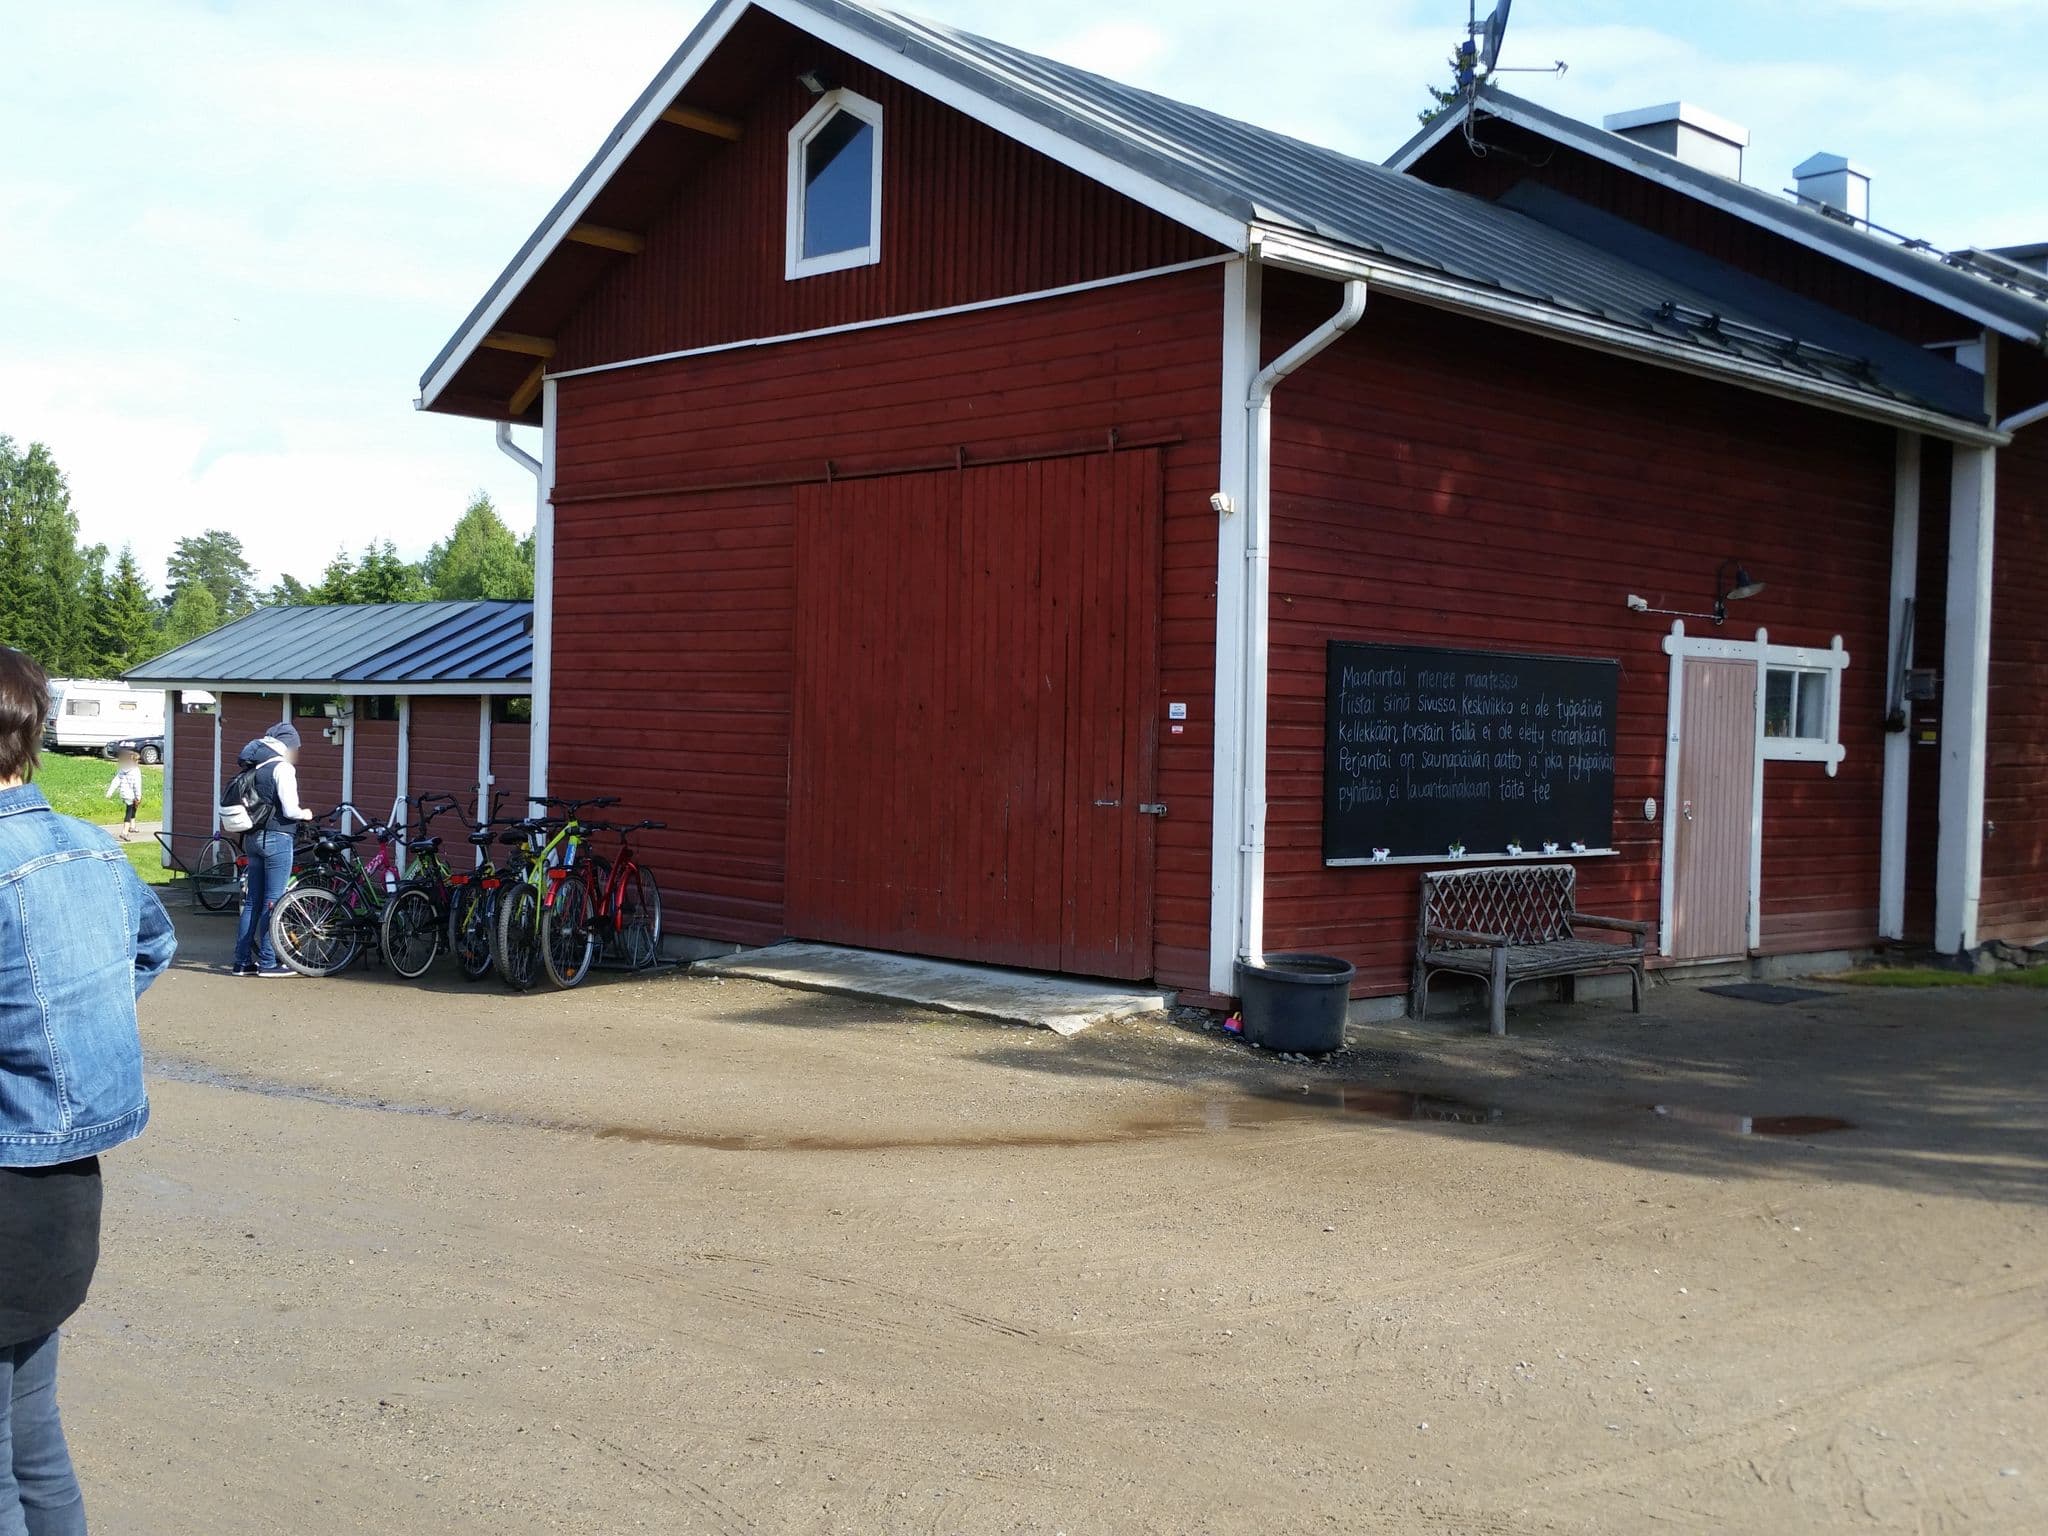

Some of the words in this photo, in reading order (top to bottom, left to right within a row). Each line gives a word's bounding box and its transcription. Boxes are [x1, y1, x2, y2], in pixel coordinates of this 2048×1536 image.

[1417, 670, 1456, 689] menee
[1520, 698, 1529, 716] ei
[1535, 691, 1549, 718] ole
[1482, 723, 1491, 741] ei
[1498, 719, 1513, 740] ole
[1339, 746, 1391, 778] Perjantai
[1399, 752, 1415, 769] on
[1524, 751, 1538, 777] ja
[1532, 779, 1550, 804] tee
